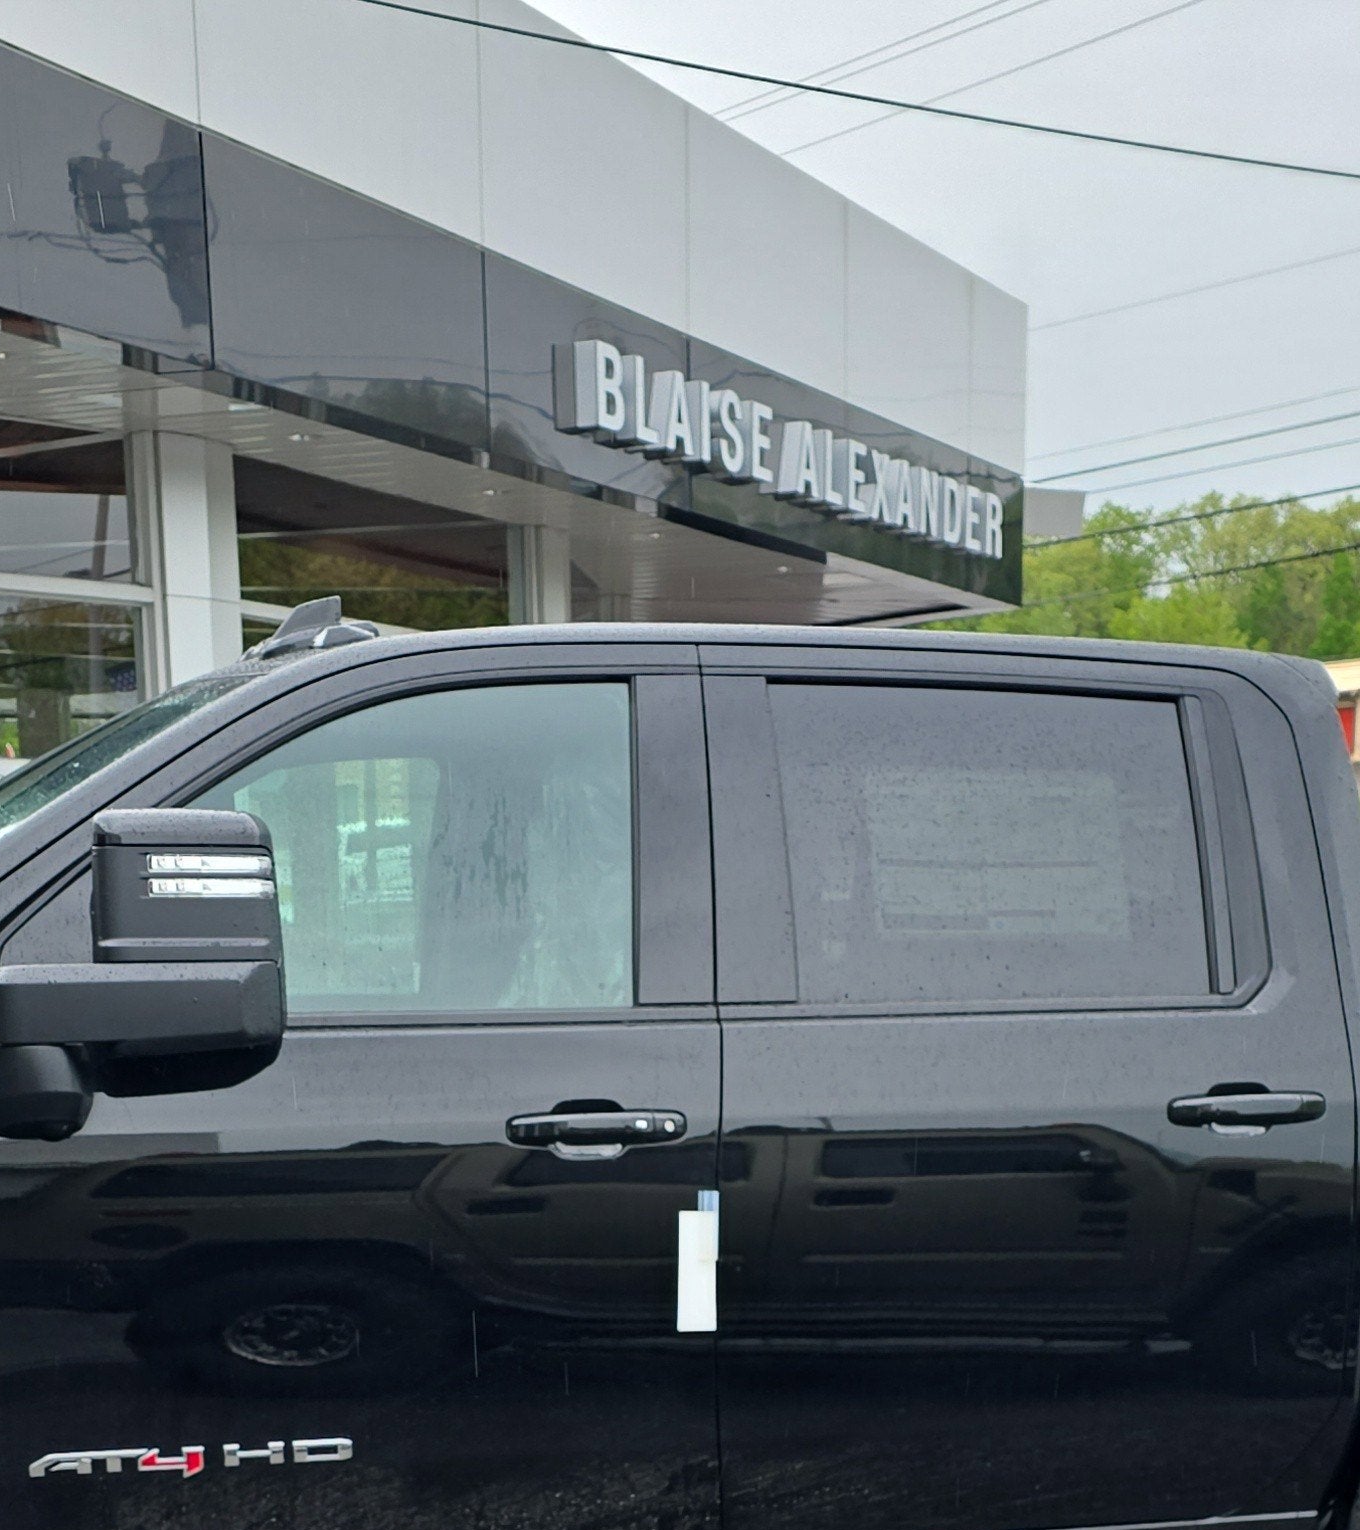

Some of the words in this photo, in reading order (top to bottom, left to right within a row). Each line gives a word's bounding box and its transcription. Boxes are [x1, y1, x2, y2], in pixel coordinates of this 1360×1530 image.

[575, 340, 774, 484] BLAISE
[776, 420, 1004, 560] ALEXANDER
[29, 1446, 205, 1478] AT4
[222, 1437, 353, 1467] HD
